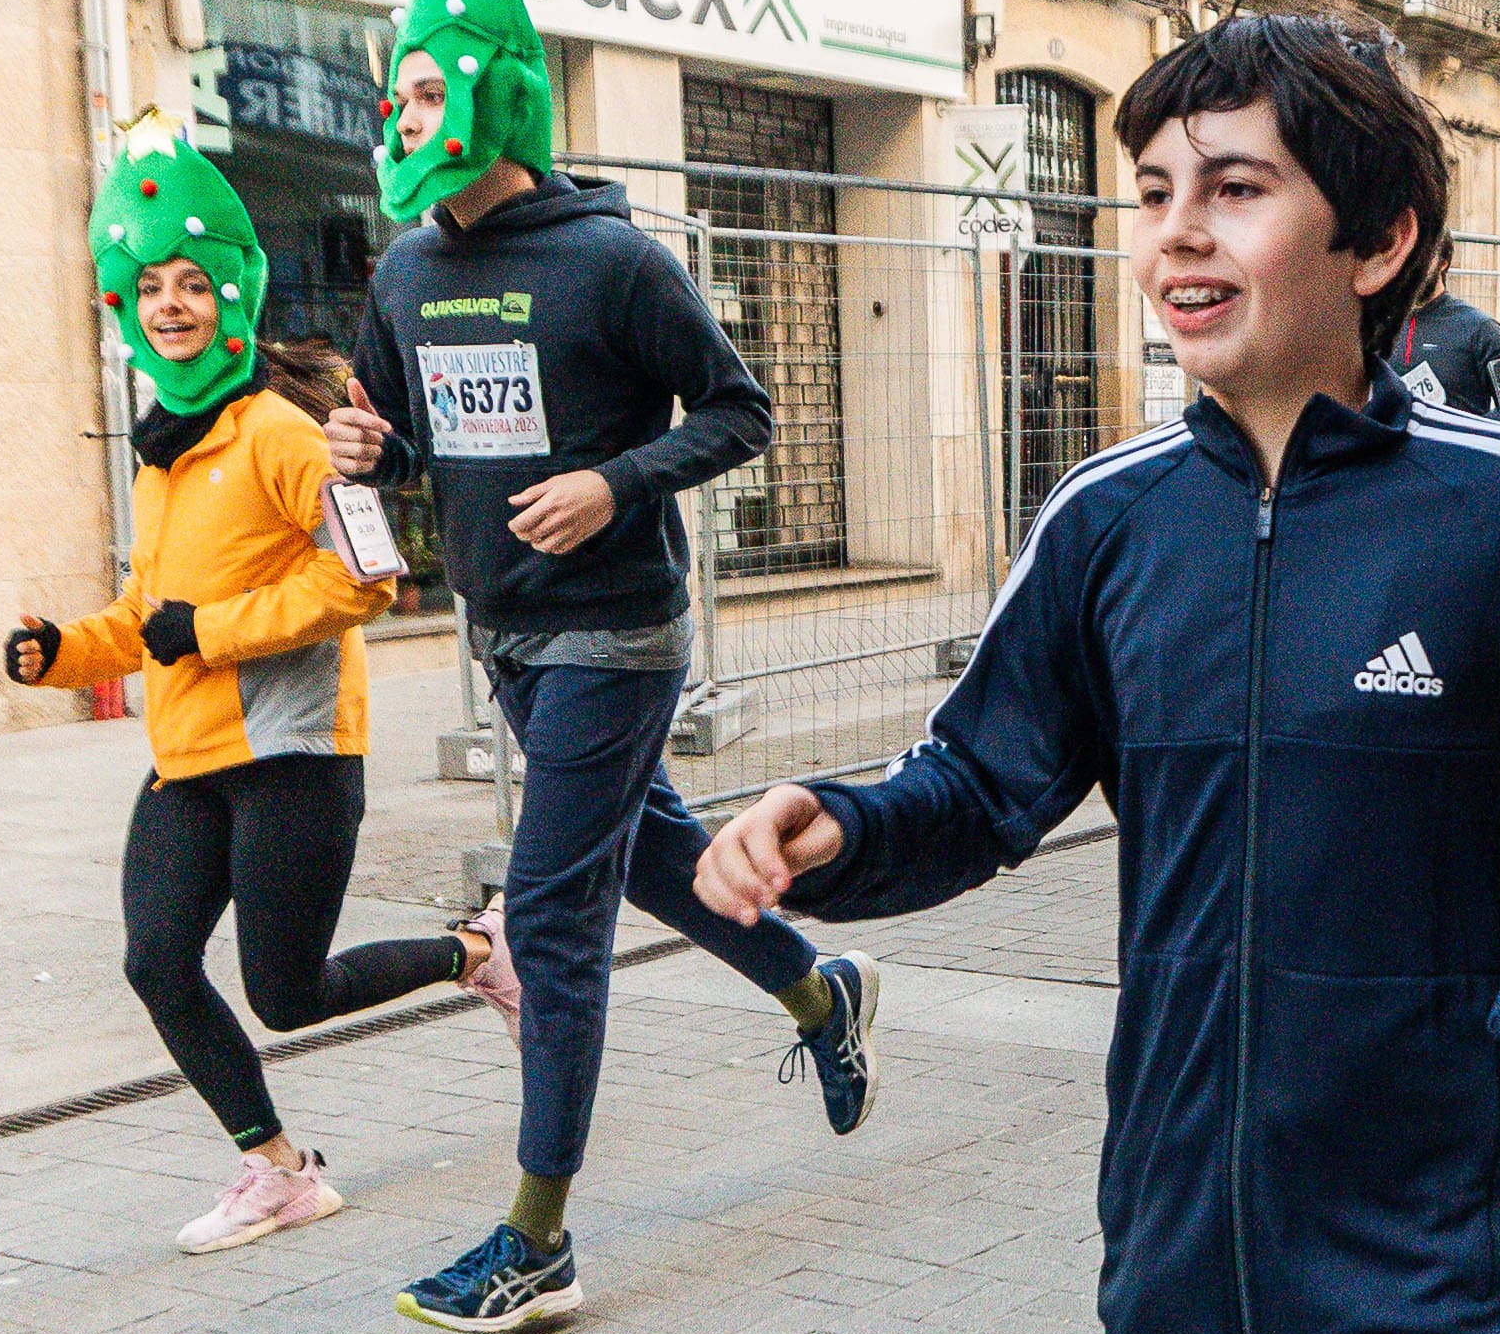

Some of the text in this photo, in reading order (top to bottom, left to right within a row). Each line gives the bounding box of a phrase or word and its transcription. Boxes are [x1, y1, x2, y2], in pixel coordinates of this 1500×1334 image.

[875, 26, 908, 48] digital
[420, 297, 500, 319] QUIKSILVER
[443, 352, 465, 374] SAN
[467, 351, 529, 373] SILVESTRE
[459, 376, 533, 413] 6373
[462, 417, 538, 435] PONTEVEDRA 2025
[1353, 668, 1444, 697] adidas
